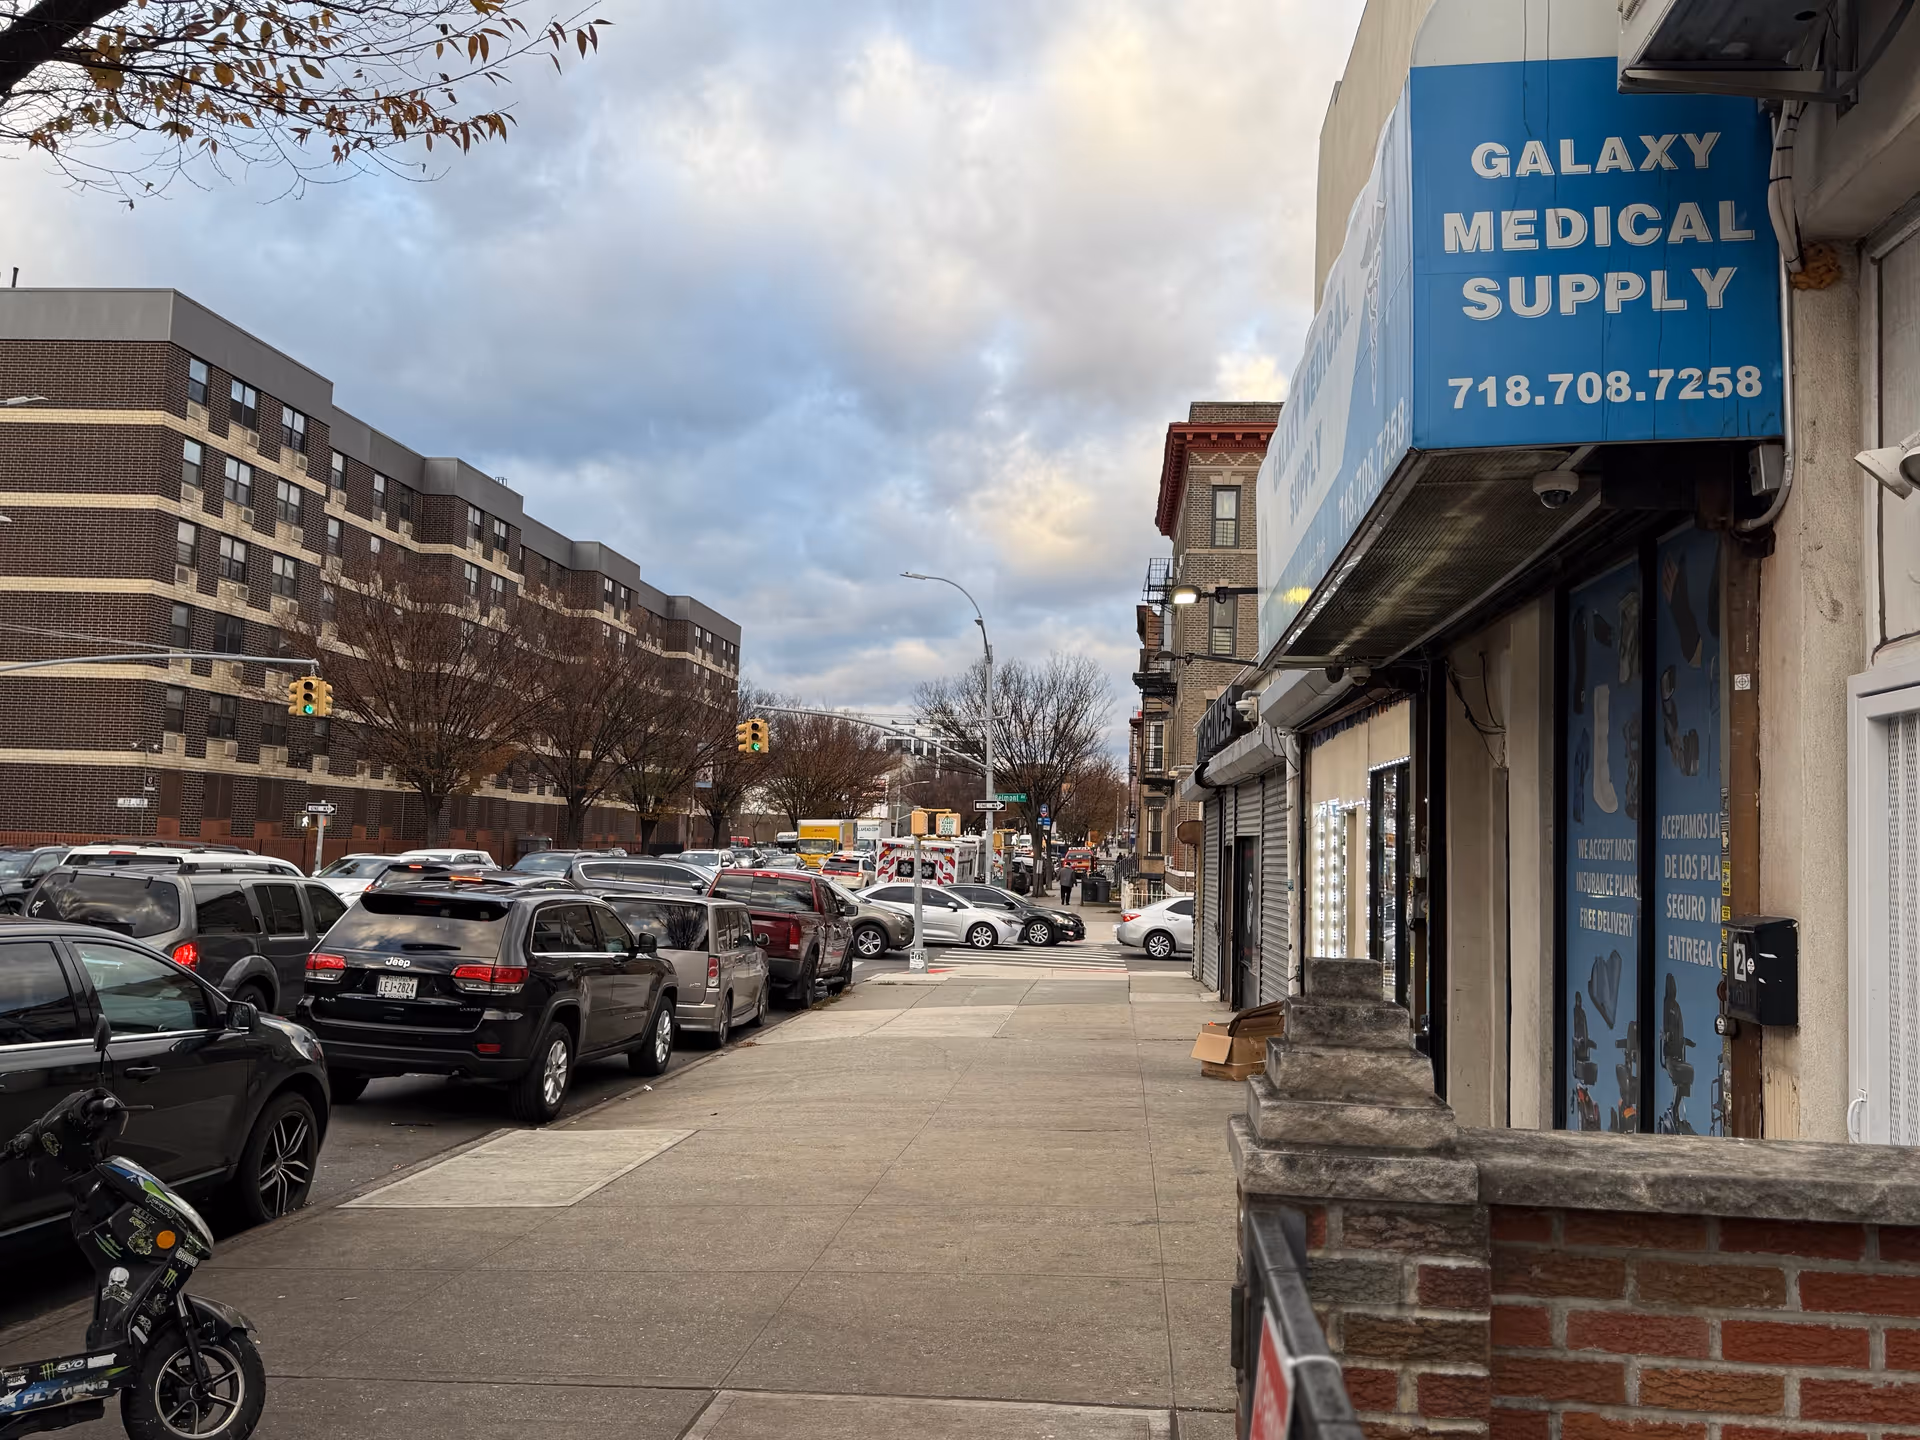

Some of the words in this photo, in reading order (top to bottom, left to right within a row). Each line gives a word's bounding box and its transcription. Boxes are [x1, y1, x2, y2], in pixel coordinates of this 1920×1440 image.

[1471, 132, 1721, 179] GALAXY
[1443, 200, 1755, 253] MEDICAL
[1462, 267, 1737, 320] SUPPLY
[1273, 394, 1300, 493] GALAXY
[1303, 277, 1349, 423] MEDICAL
[1448, 365, 1762, 409] 718.708.7258
[1290, 420, 1322, 526] SUPPLY
[995, 794, 1018, 802] Belmont
[1661, 813, 1707, 839] ACEPTAMOS
[1577, 839, 1588, 859] WE
[1589, 839, 1614, 861] ACCEPT
[1615, 839, 1636, 862] MOST
[1664, 855, 1677, 879] DE
[1680, 855, 1698, 880] LOS
[1576, 872, 1614, 895] INSURANCE
[1615, 874, 1638, 899] PLANS
[1580, 907, 1596, 930] FREE
[1598, 910, 1634, 937] DELIVERY
[1666, 893, 1706, 922] SEGURO
[385, 957, 410, 968] Jeep
[1668, 935, 1713, 967] ENTREGA
[1736, 949, 1745, 976] 2
[58, 1359, 84, 1371] EVO
